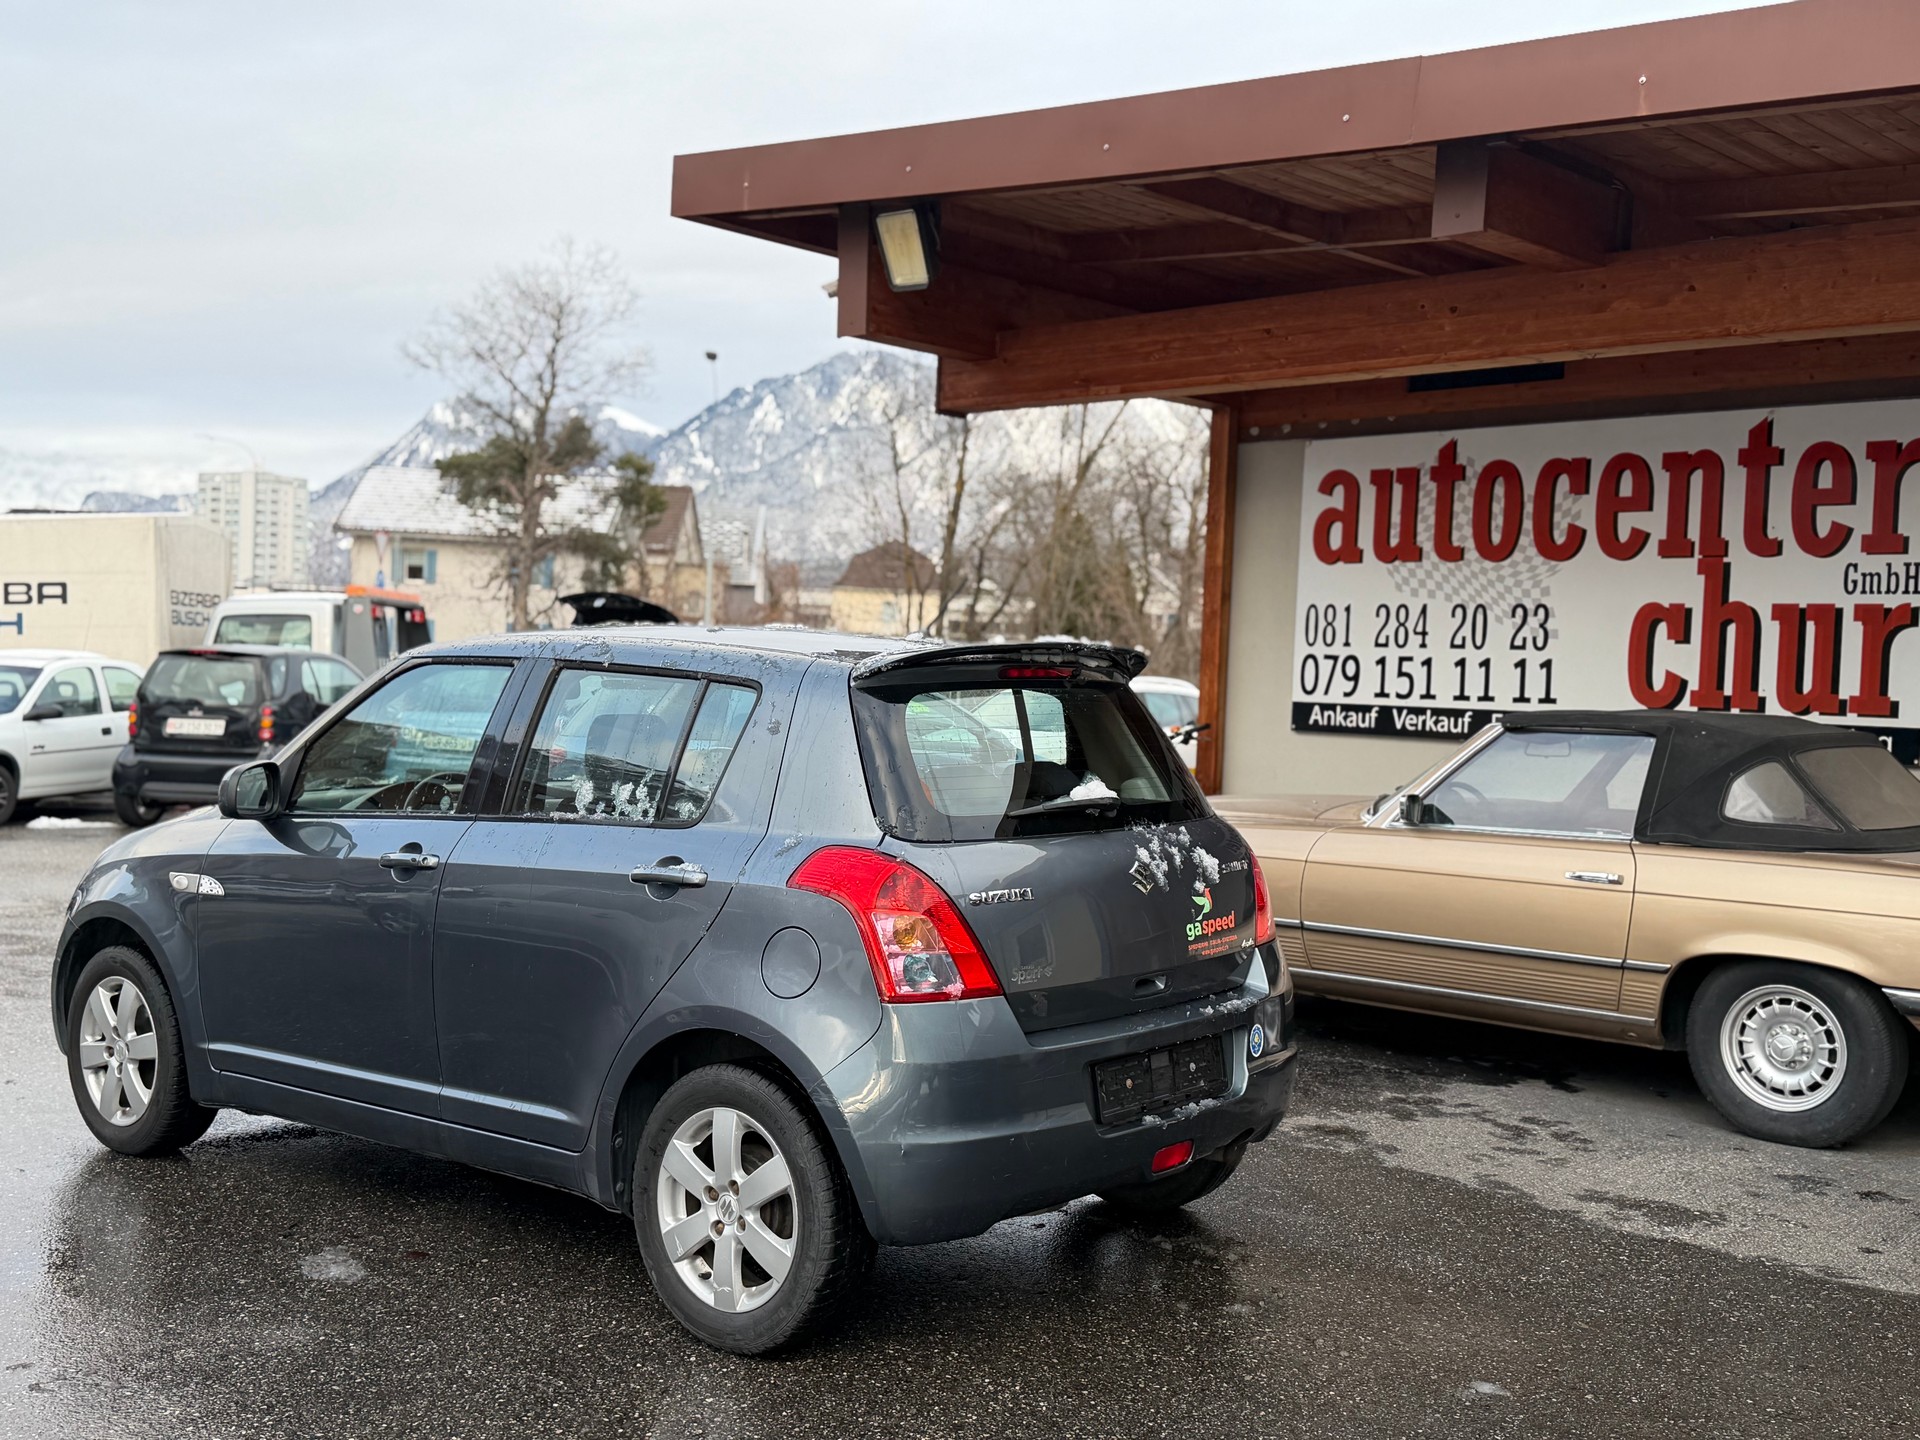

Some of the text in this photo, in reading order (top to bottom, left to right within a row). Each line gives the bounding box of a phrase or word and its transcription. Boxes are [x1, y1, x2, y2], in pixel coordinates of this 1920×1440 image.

[1312, 416, 1920, 566] autocenter
[1843, 561, 1920, 596] GmbH
[1304, 603, 1550, 652] 081 284 20 23
[1627, 554, 1919, 719] chur
[1300, 653, 1558, 705] 079 151 11 11
[1308, 703, 1380, 729] Ankauf
[1392, 707, 1473, 735] Verkauf
[968, 886, 1035, 907] SUZUKI
[1186, 910, 1235, 941] gaspeed
